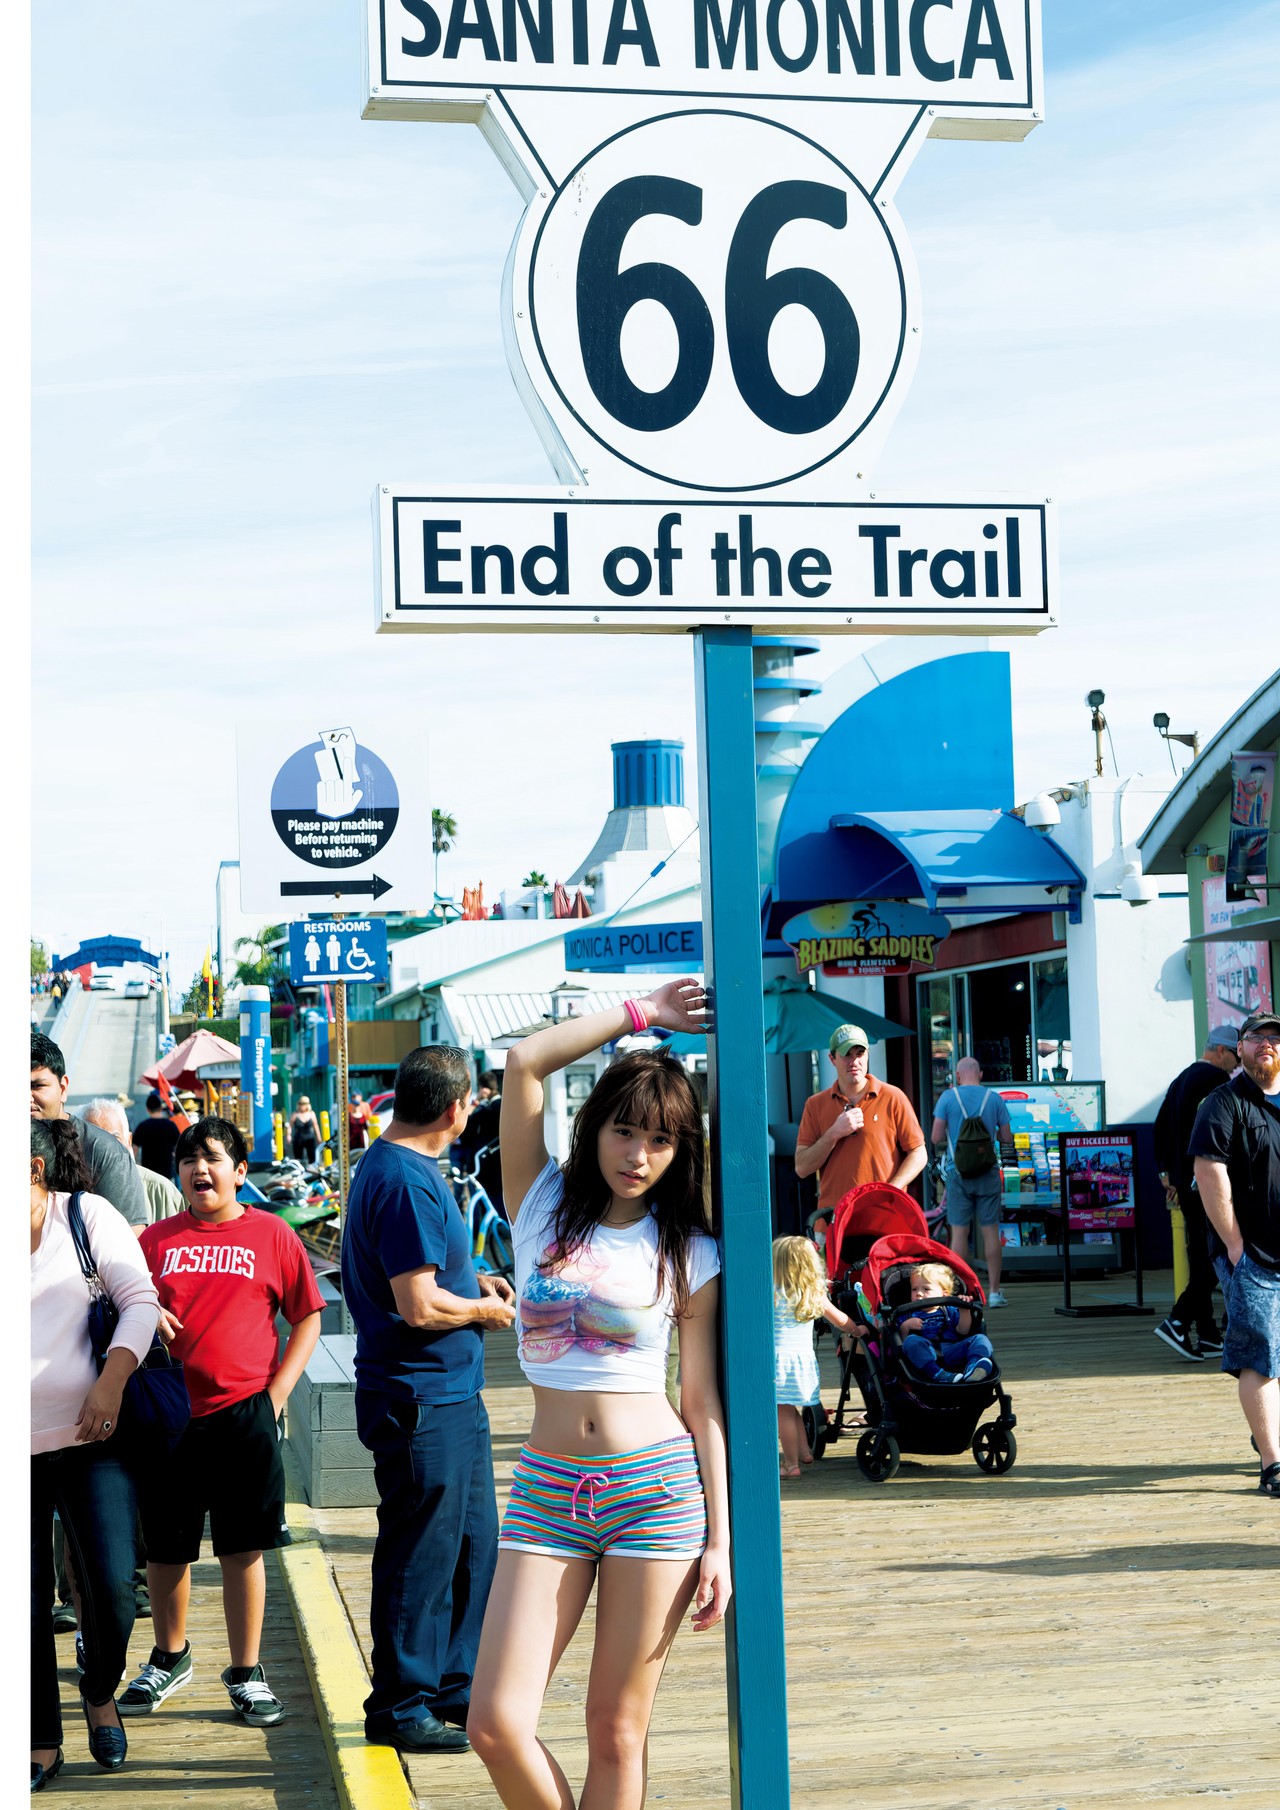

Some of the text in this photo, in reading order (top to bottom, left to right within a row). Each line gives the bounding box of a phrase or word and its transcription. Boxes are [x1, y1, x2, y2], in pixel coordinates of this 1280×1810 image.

[401, 0, 1014, 82] SANTA MONICA
[576, 175, 860, 434] 66
[423, 512, 1022, 598] End of the Trail
[288, 819, 384, 833] Please pay machine
[295, 832, 377, 846] Before returning
[311, 846, 362, 858] to vehicle.
[304, 921, 371, 933] RESTROOMS
[570, 930, 694, 959] MONICA POLICE
[798, 936, 935, 969] BLAZING SADDLES
[254, 1038, 265, 1108] Emergency
[1066, 1138, 1080, 1146] BUY
